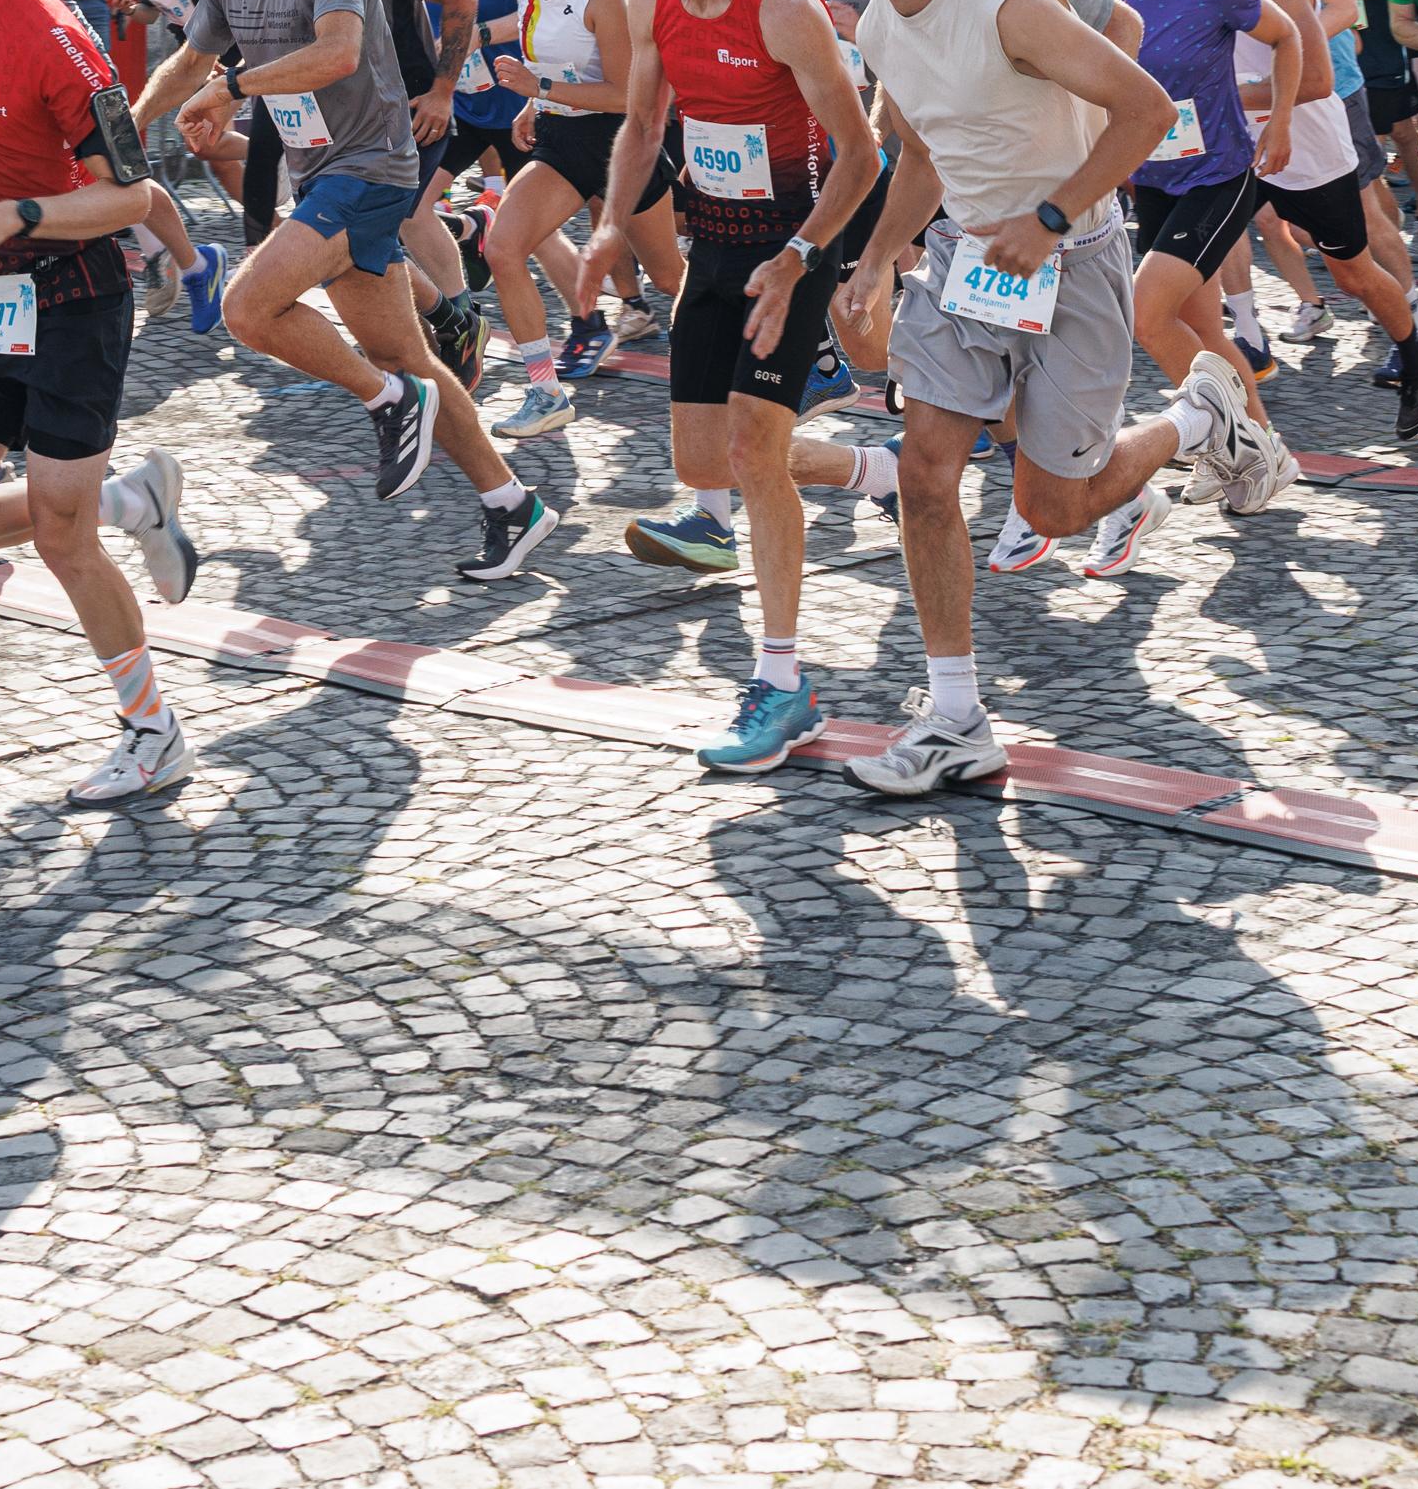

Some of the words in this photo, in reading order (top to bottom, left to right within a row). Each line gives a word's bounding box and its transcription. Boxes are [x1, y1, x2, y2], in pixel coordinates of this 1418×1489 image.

[693, 145, 742, 174] 4590
[964, 265, 1029, 301] 4784
[969, 292, 1011, 311] Benjamin
[754, 370, 783, 385] GORE
